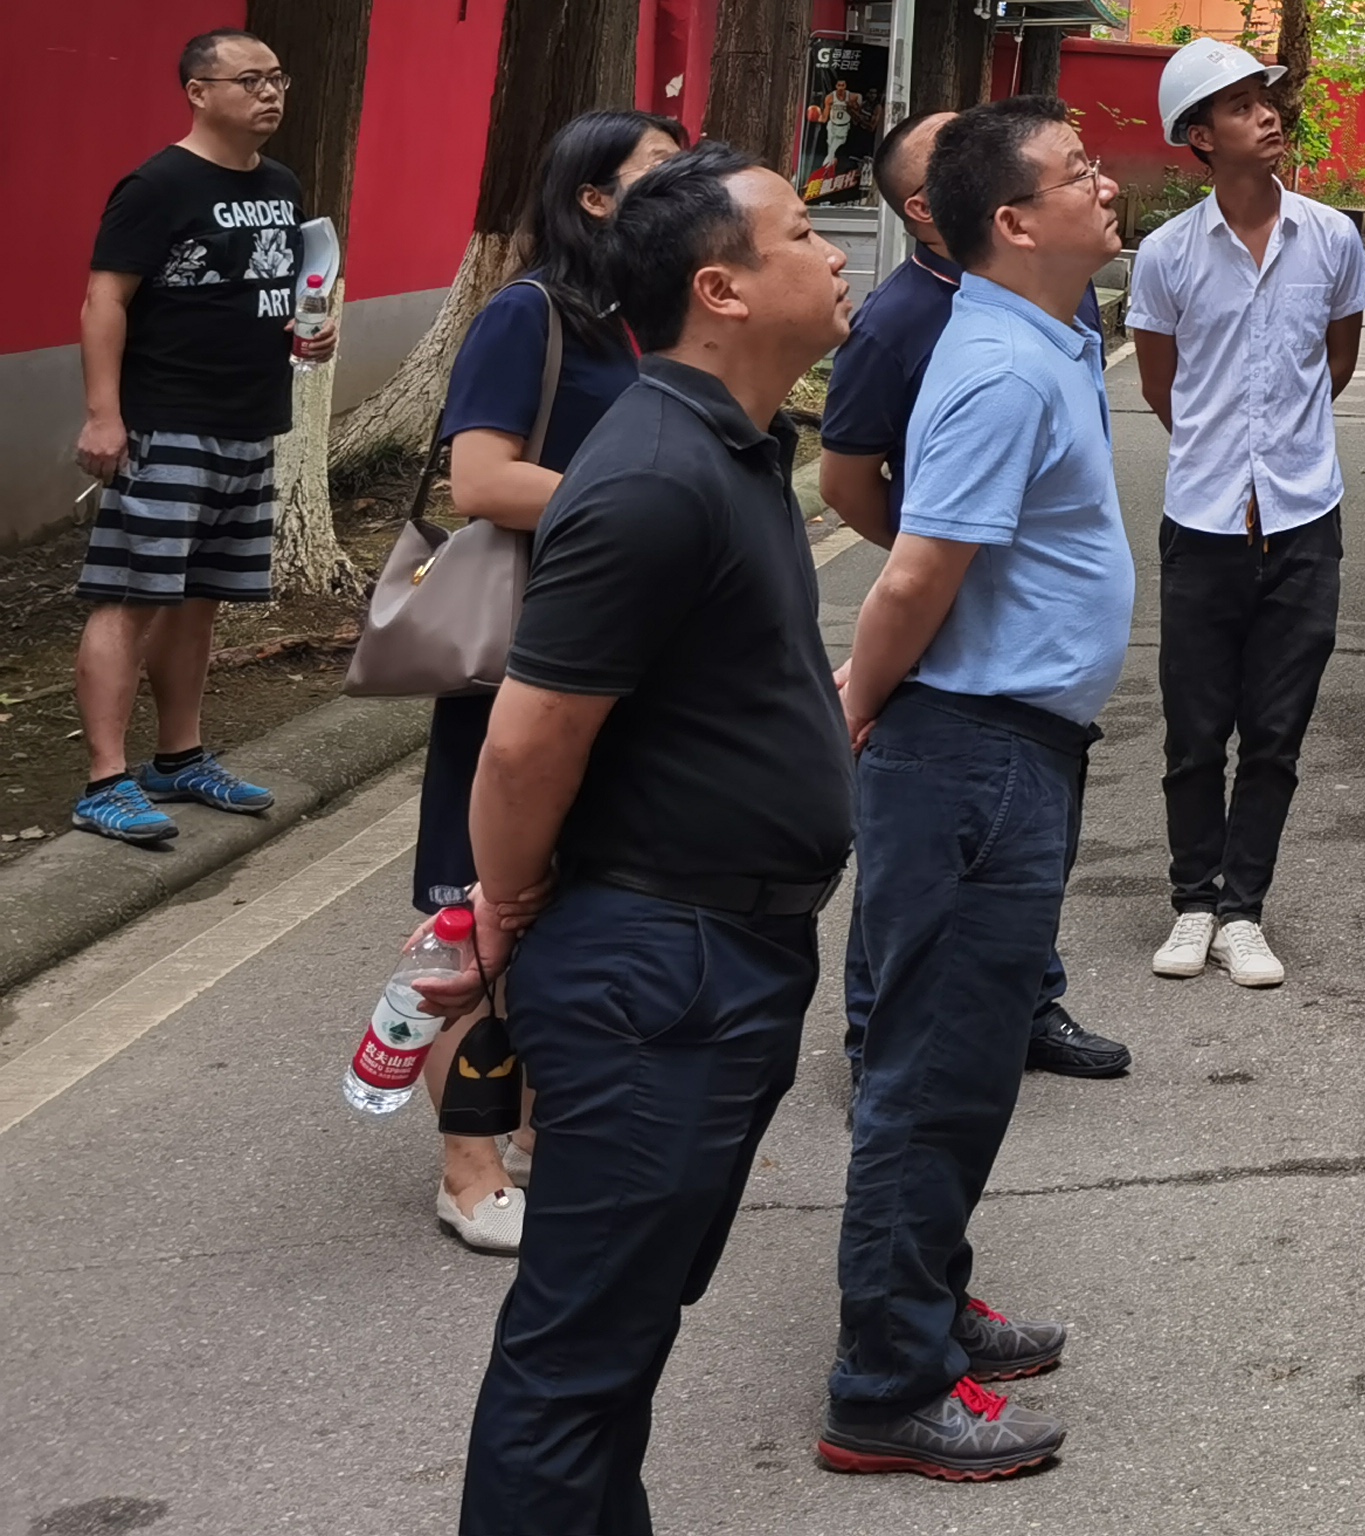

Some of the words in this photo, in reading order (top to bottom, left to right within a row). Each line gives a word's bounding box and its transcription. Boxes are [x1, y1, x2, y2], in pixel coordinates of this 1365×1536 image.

[213, 200, 296, 228] GARDEN
[257, 288, 290, 317] ART
[365, 1040, 419, 1068] 农夫山泉
